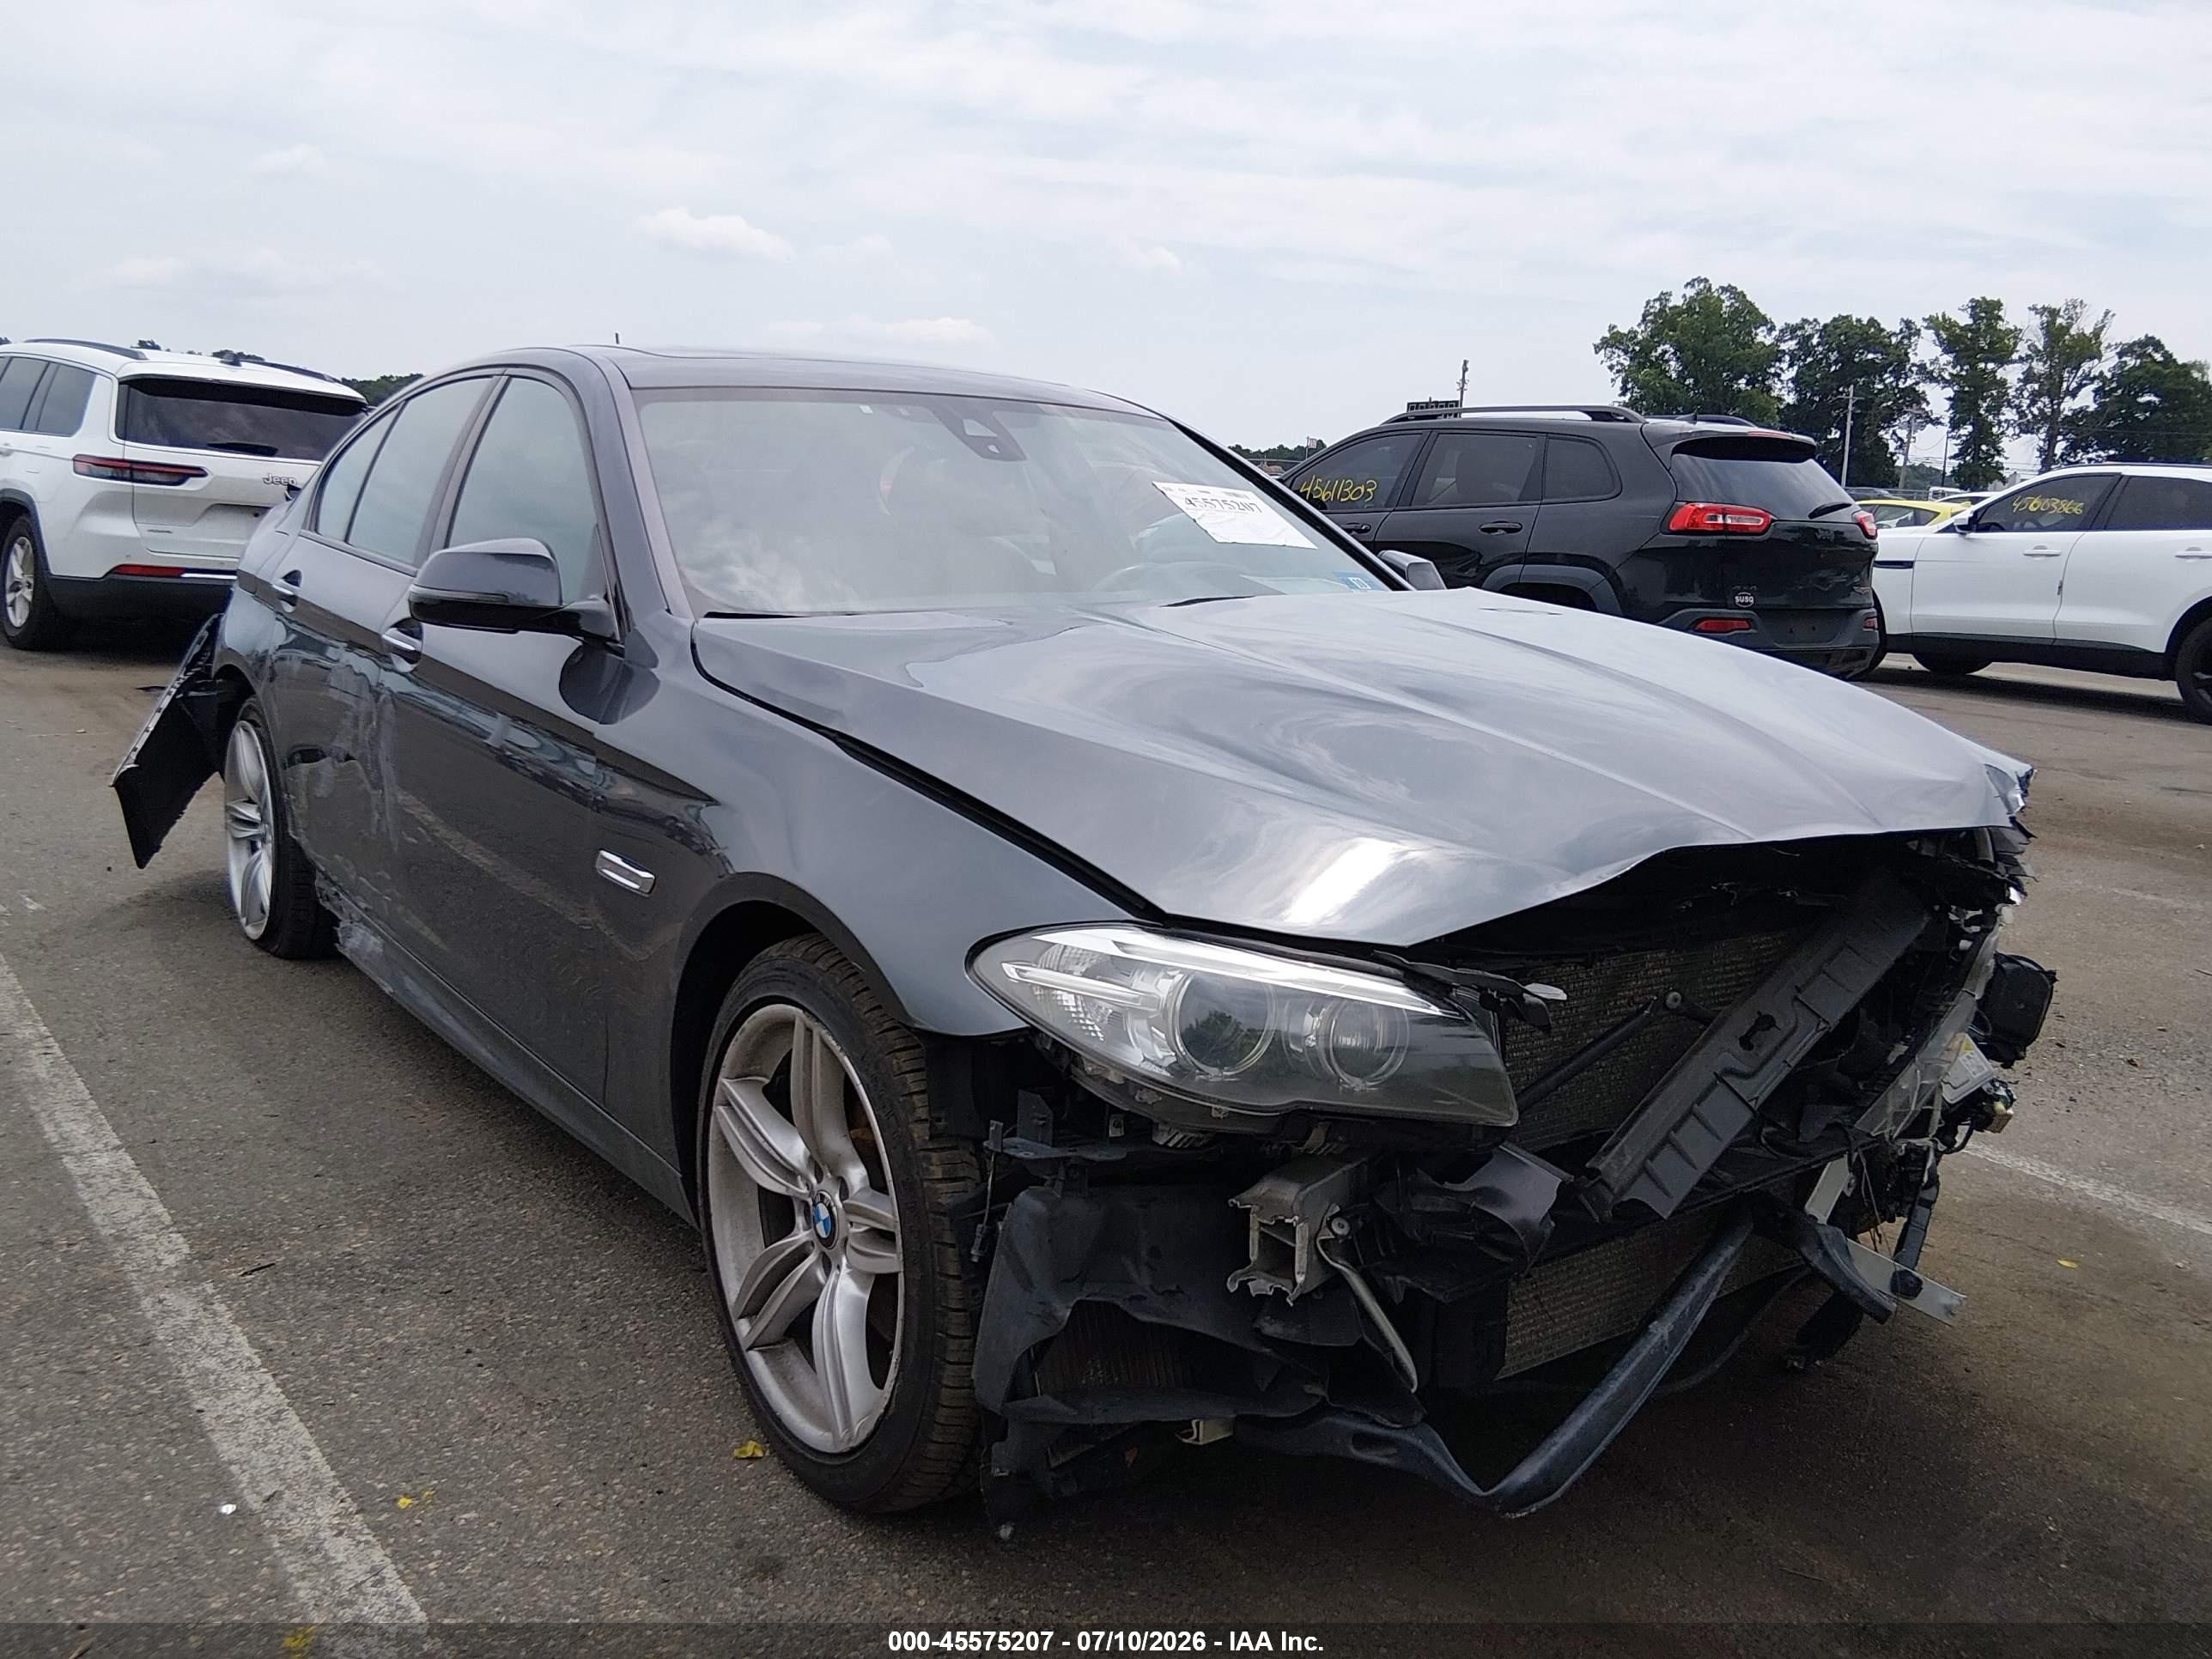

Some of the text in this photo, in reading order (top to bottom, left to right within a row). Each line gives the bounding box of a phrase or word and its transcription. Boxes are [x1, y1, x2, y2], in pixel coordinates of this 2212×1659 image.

[262, 472, 296, 486] Jeep
[1299, 474, 1377, 502] 45611303
[2012, 495, 2085, 514] 45603866
